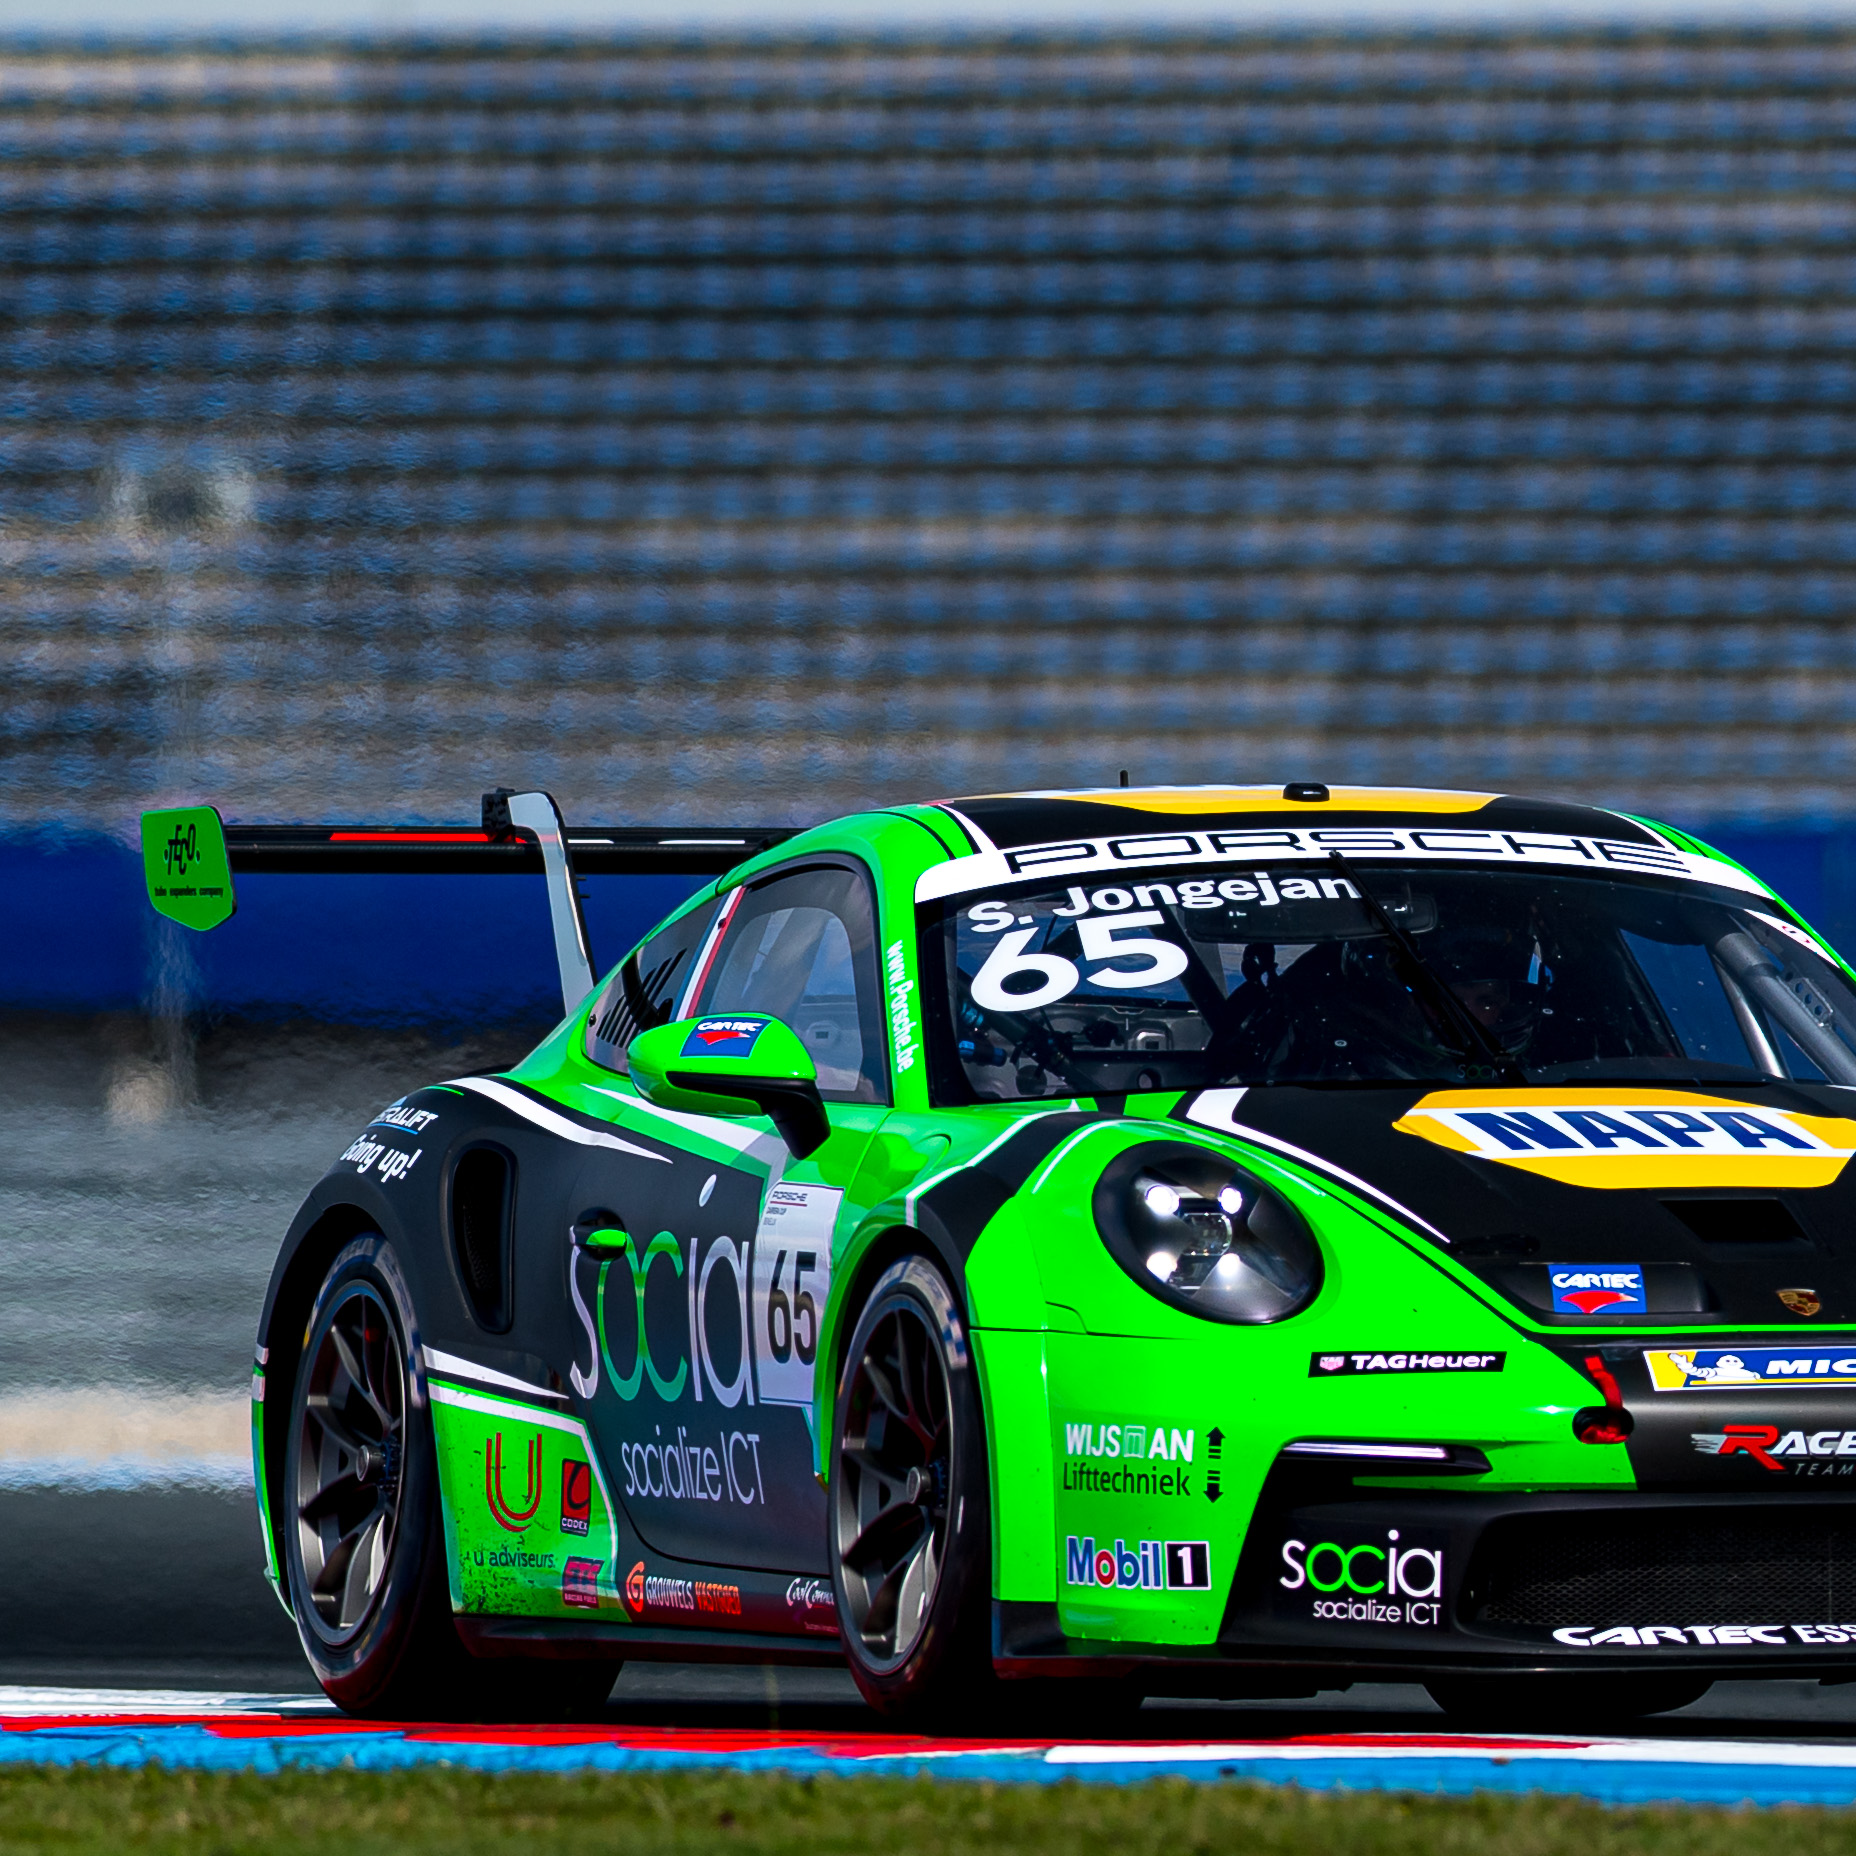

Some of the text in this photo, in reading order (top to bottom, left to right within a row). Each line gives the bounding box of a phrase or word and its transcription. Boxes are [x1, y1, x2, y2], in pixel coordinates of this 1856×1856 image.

[1004, 827, 1692, 875] PORSCHE
[968, 872, 1363, 933] S. Jongejan
[970, 910, 1188, 1012] 65
[887, 939, 919, 1073] www.Porsche.be
[1455, 1110, 1818, 1151] NAPA
[377, 1148, 423, 1183] up!
[1552, 1272, 1641, 1289] CARTEC
[767, 1249, 817, 1365] 65
[621, 1424, 764, 1504] socialize ICT
[1063, 1462, 1191, 1496] Lifttechniek
[1794, 1463, 1855, 1476] TEAM
[561, 1517, 588, 1531] CODEX
[1066, 1535, 1163, 1590] Mobil
[1279, 1529, 1441, 1598] socia
[645, 1576, 694, 1610] GROUWELS
[694, 1581, 742, 1615] VASTGOED
[1313, 1597, 1441, 1625] socialize ICT
[1552, 1624, 1787, 1647] CARTEC
